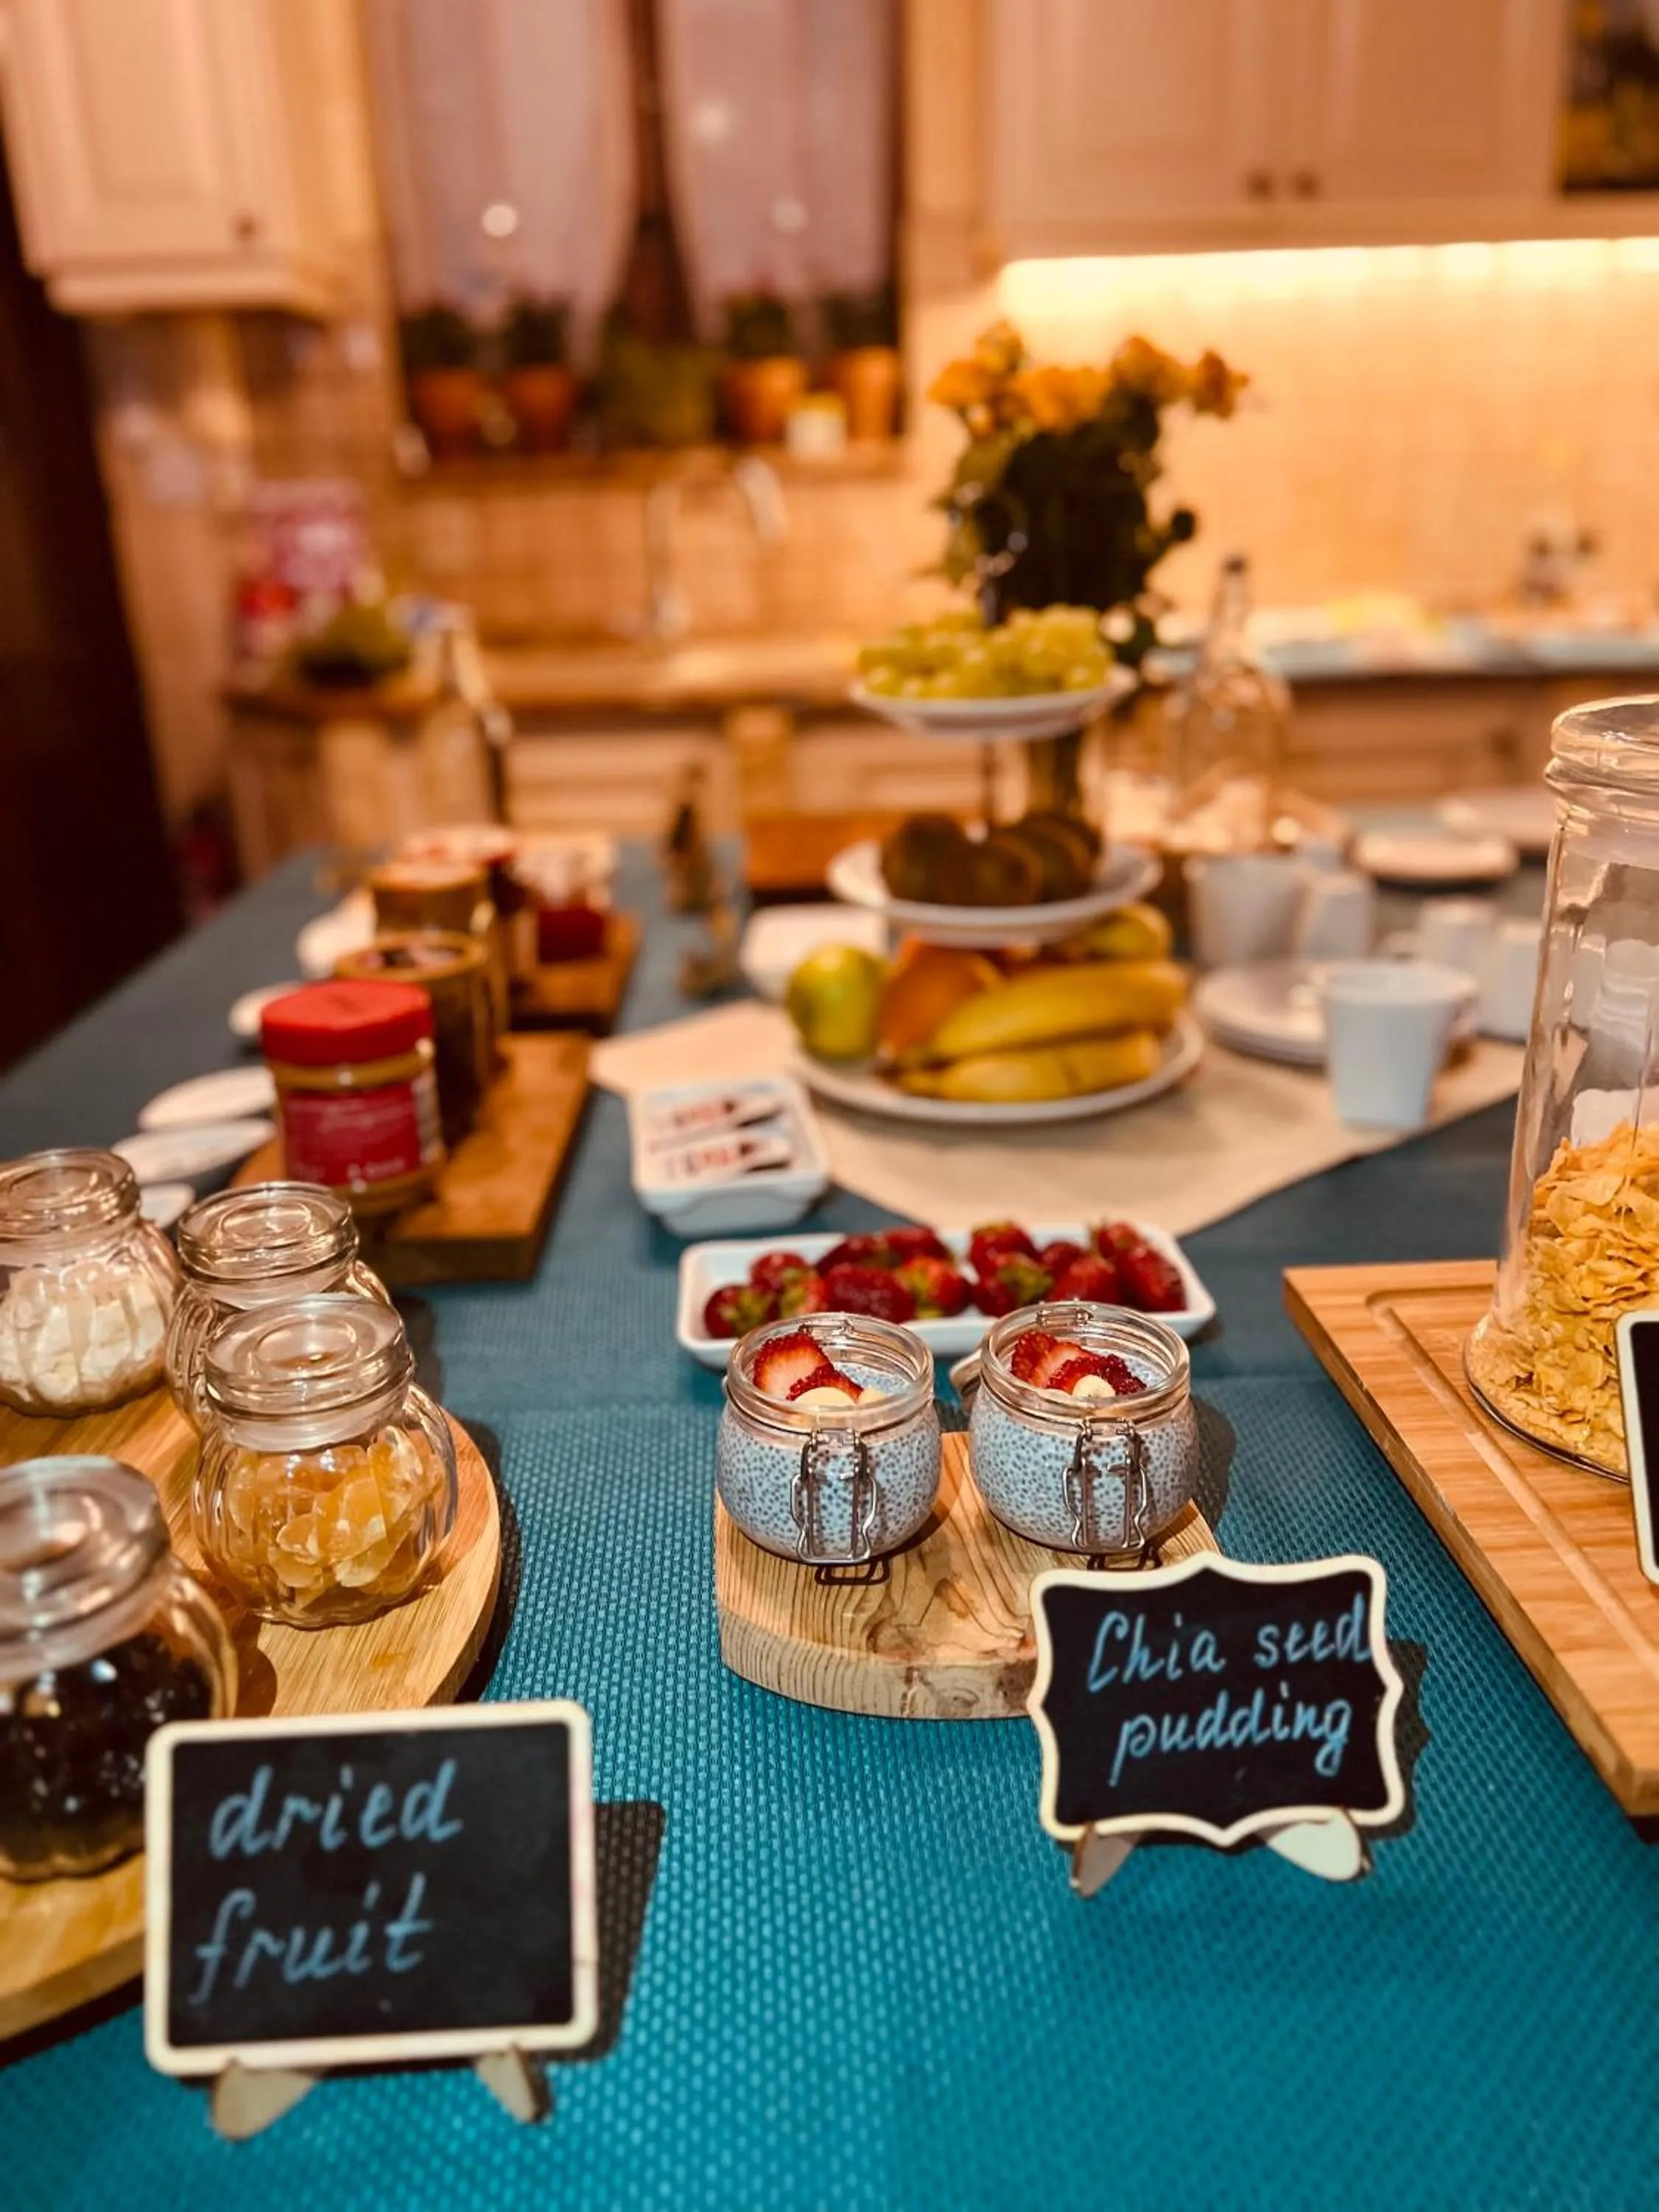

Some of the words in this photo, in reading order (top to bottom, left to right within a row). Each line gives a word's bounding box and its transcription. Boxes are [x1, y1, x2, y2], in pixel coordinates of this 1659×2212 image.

[1087, 1610, 1226, 1692] Chia
[1253, 1592, 1372, 1668] seed
[1107, 1680, 1352, 1787] pudding
[209, 1759, 464, 1860] dried
[187, 1872, 434, 2005] fruit
